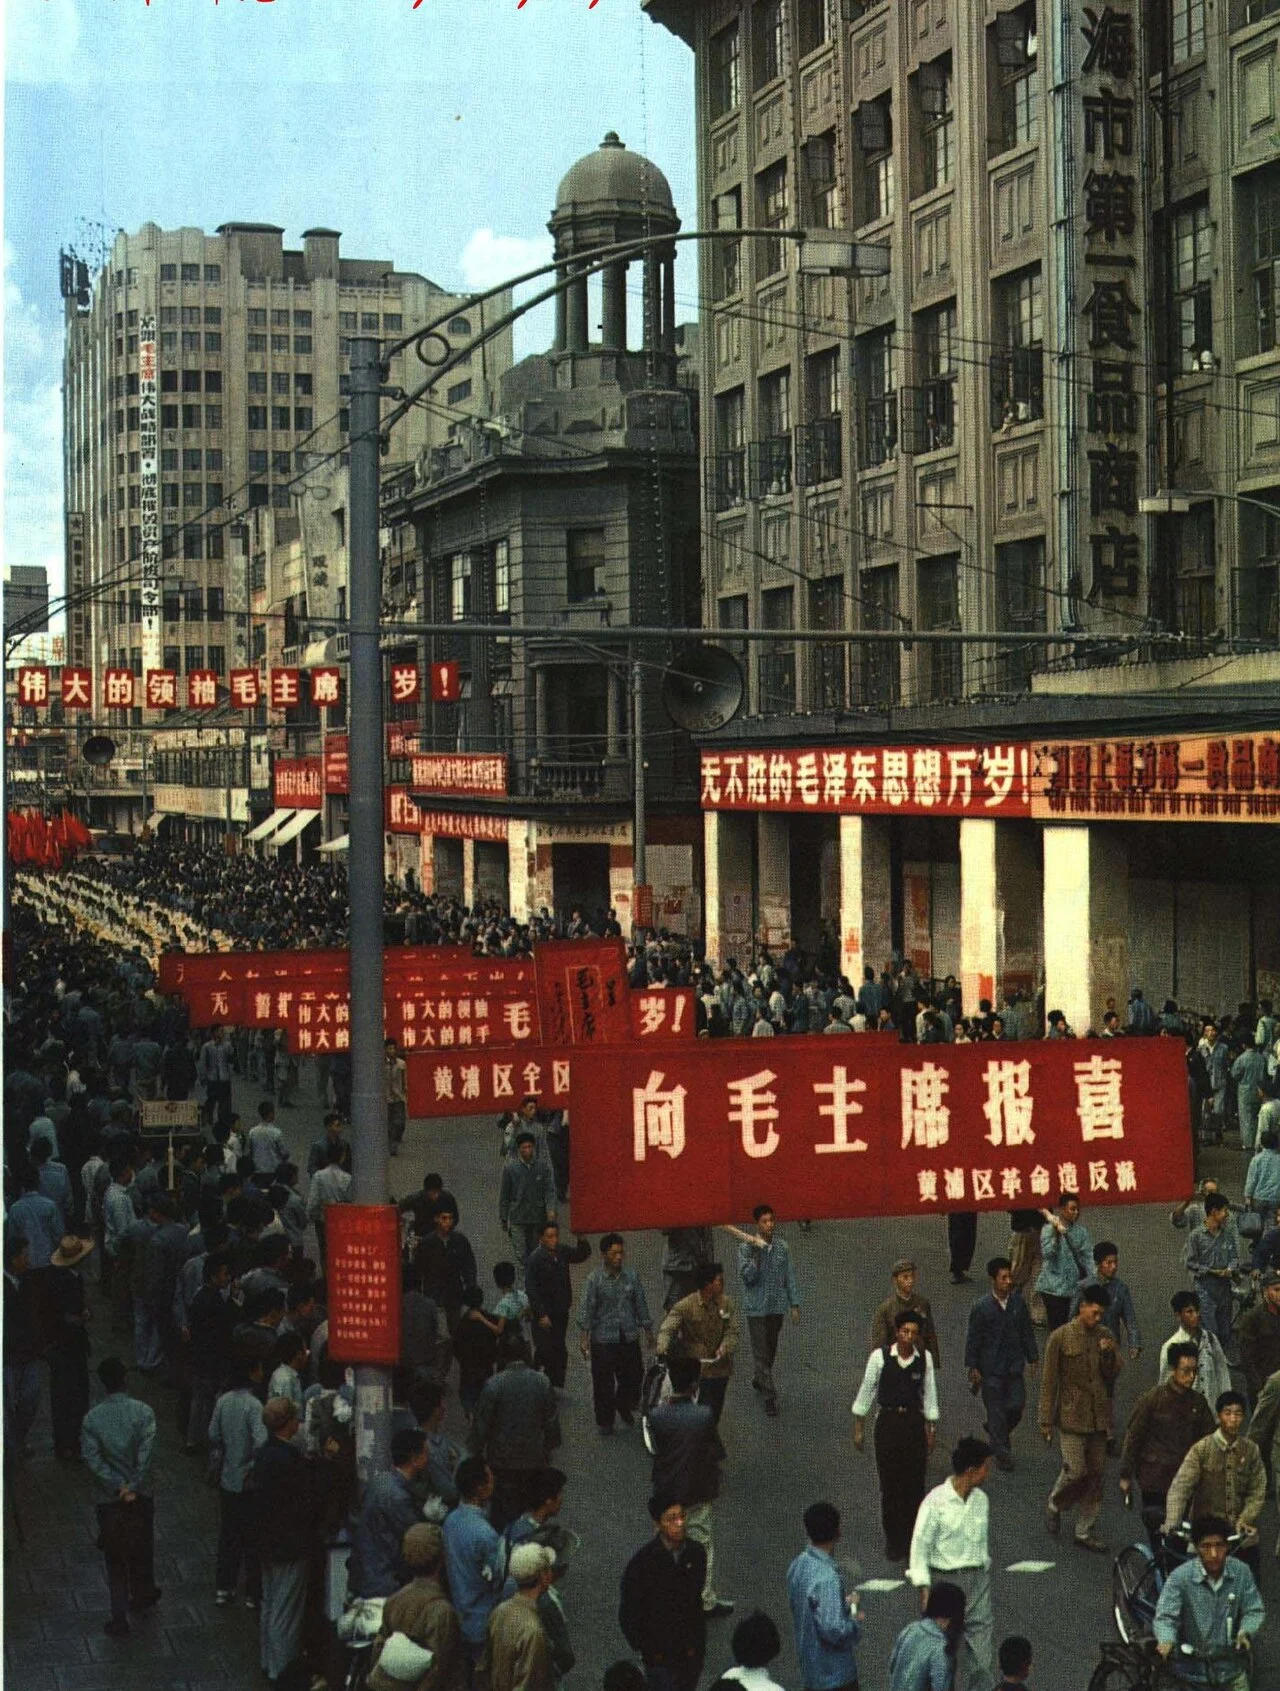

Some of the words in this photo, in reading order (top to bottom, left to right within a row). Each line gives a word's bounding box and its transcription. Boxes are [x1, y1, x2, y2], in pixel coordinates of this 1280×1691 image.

[20, 668, 449, 706] 伟大的领袖毛主席岁!
[632, 1054, 1126, 1161] 向毛主席报喜
[916, 1160, 1138, 1203] 黄浦区革命造反派
